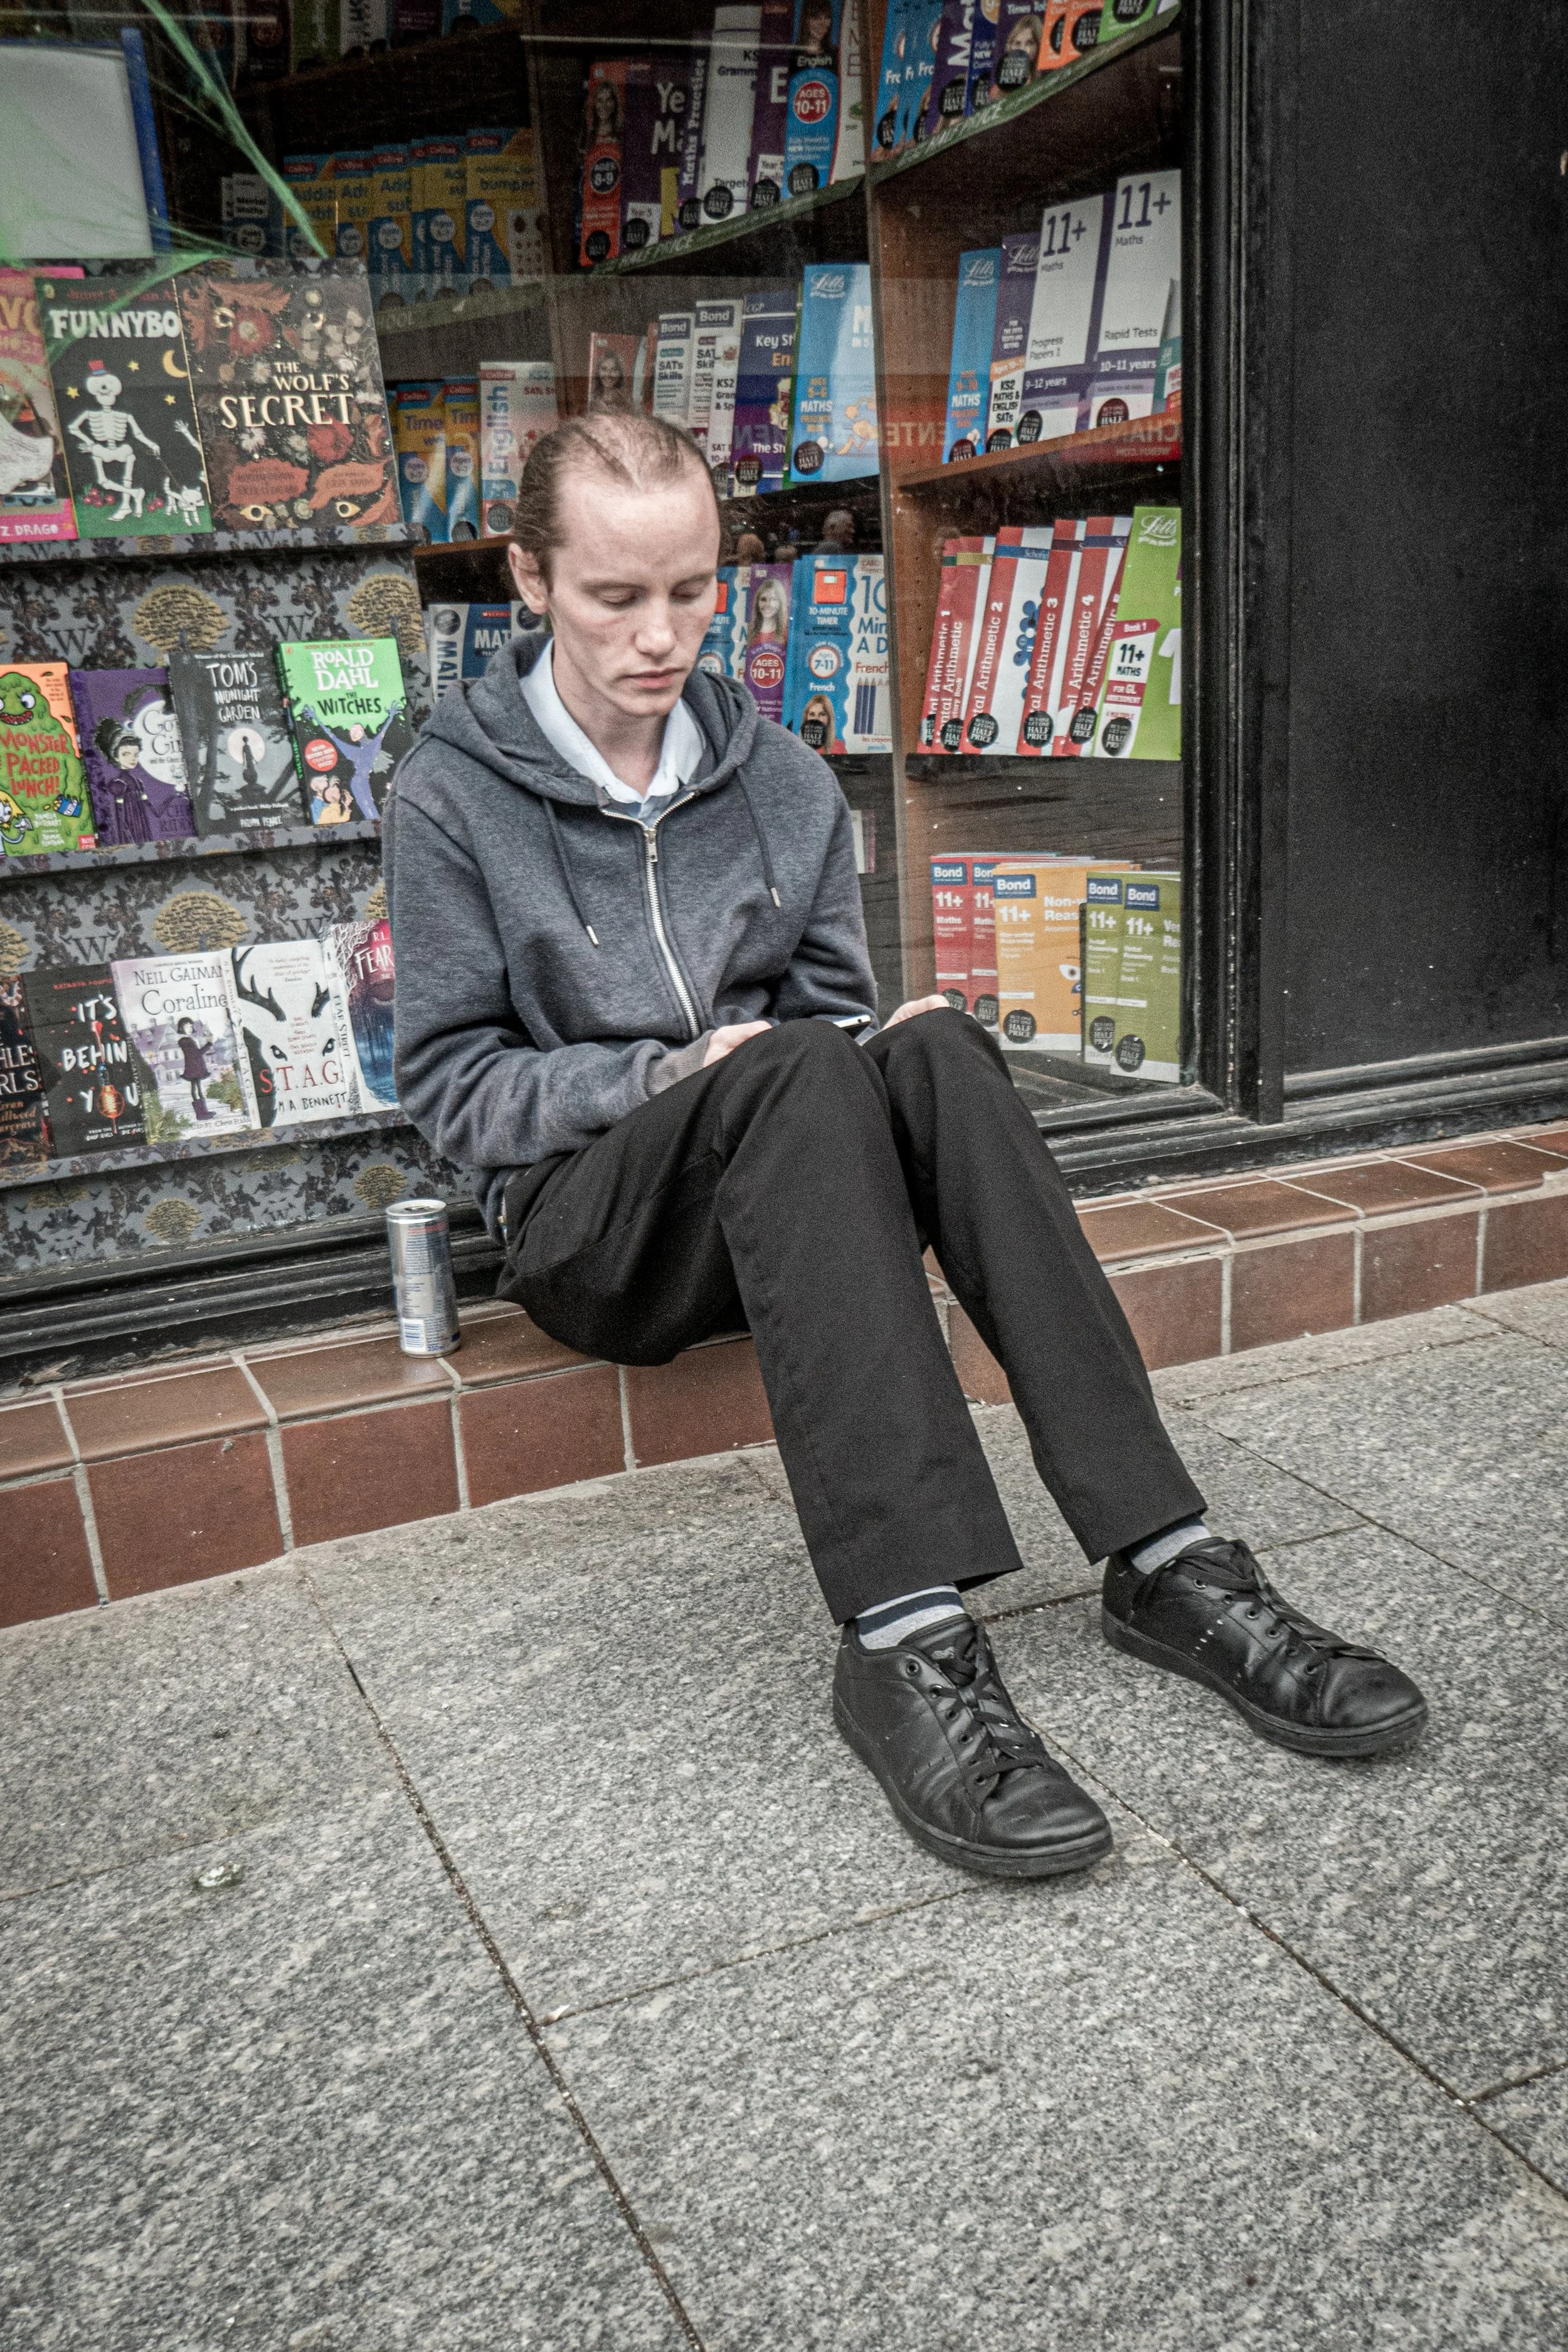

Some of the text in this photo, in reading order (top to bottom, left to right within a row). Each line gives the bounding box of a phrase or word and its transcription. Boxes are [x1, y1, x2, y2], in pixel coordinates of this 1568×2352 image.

[796, 55, 833, 68] English
[974, 50, 991, 58] NEW
[800, 88, 825, 98] AGES
[795, 100, 827, 115] 10-11
[1117, 181, 1172, 231] 11+
[1042, 211, 1087, 258] 11+
[700, 310, 730, 322] Bond
[48, 309, 182, 339] FUNNYBO
[660, 322, 687, 333] Bond
[756, 334, 779, 349] Key
[1104, 327, 1158, 342] Rapid Tests
[273, 361, 301, 374] THE
[1100, 359, 1157, 373] 10-11 years
[272, 373, 349, 392] WOLF'S
[716, 378, 734, 389] KS2
[1000, 379, 1016, 391] KS2
[1044, 377, 1067, 388] years
[951, 393, 982, 407] MATHS
[993, 391, 1020, 401] MATHS &
[220, 393, 354, 429] SECRET
[800, 400, 834, 413] MATHS
[995, 412, 1014, 423] SATs
[487, 384, 514, 474] English
[753, 443, 771, 453] The
[14, 523, 59, 537] DRAGO
[1140, 515, 1178, 538] Letts
[808, 607, 849, 616] 10-MINUTE
[817, 617, 839, 626] TIMER
[857, 636, 870, 654] A
[975, 601, 1004, 692] Arithmetic 2
[1032, 597, 1059, 691] Arithmetic 3
[1069, 595, 1095, 691] Arithmetic 4
[1087, 610, 1118, 687] Arithmetic
[310, 647, 374, 669] ROALD
[930, 623, 949, 693] Arithmetic
[944, 622, 963, 694] Arithmetic
[1120, 643, 1145, 664] 11+
[755, 659, 780, 668] AGES
[814, 660, 835, 670] 7-11
[1116, 665, 1142, 677] MATHS
[205, 660, 258, 688] TOM'S
[315, 667, 379, 691] DAHL
[751, 669, 782, 680] 10-11
[808, 682, 835, 692] French
[213, 687, 262, 706] MIDNIGHT
[218, 703, 261, 723] GARDEN
[317, 697, 383, 716] WITCHES
[973, 727, 993, 738] HALF
[1027, 726, 1049, 734] HALF
[1073, 730, 1091, 738] PRICE
[1074, 723, 1093, 731] HALF
[0, 728, 70, 755] MONSTER
[971, 733, 992, 743] PRICE
[6, 752, 60, 778] PACKED
[9, 775, 60, 799] LUNCH!
[933, 866, 963, 878] Bond
[997, 878, 1031, 891] Bond
[1088, 882, 1118, 896] Bond
[935, 891, 964, 908] 11+
[1128, 888, 1156, 902] Bond
[936, 916, 963, 924] Maths
[999, 905, 1031, 923] 11+
[1088, 911, 1117, 929] 11+
[1126, 917, 1155, 936] 11+
[354, 944, 395, 980] FEAR
[133, 970, 167, 986] NEIL
[141, 983, 228, 1015] Coraline
[77, 992, 118, 1024] IT'S
[1009, 1024, 1032, 1032] HALF
[61, 1040, 128, 1073] BEHIN
[301, 1091, 347, 1110] BENNETT
